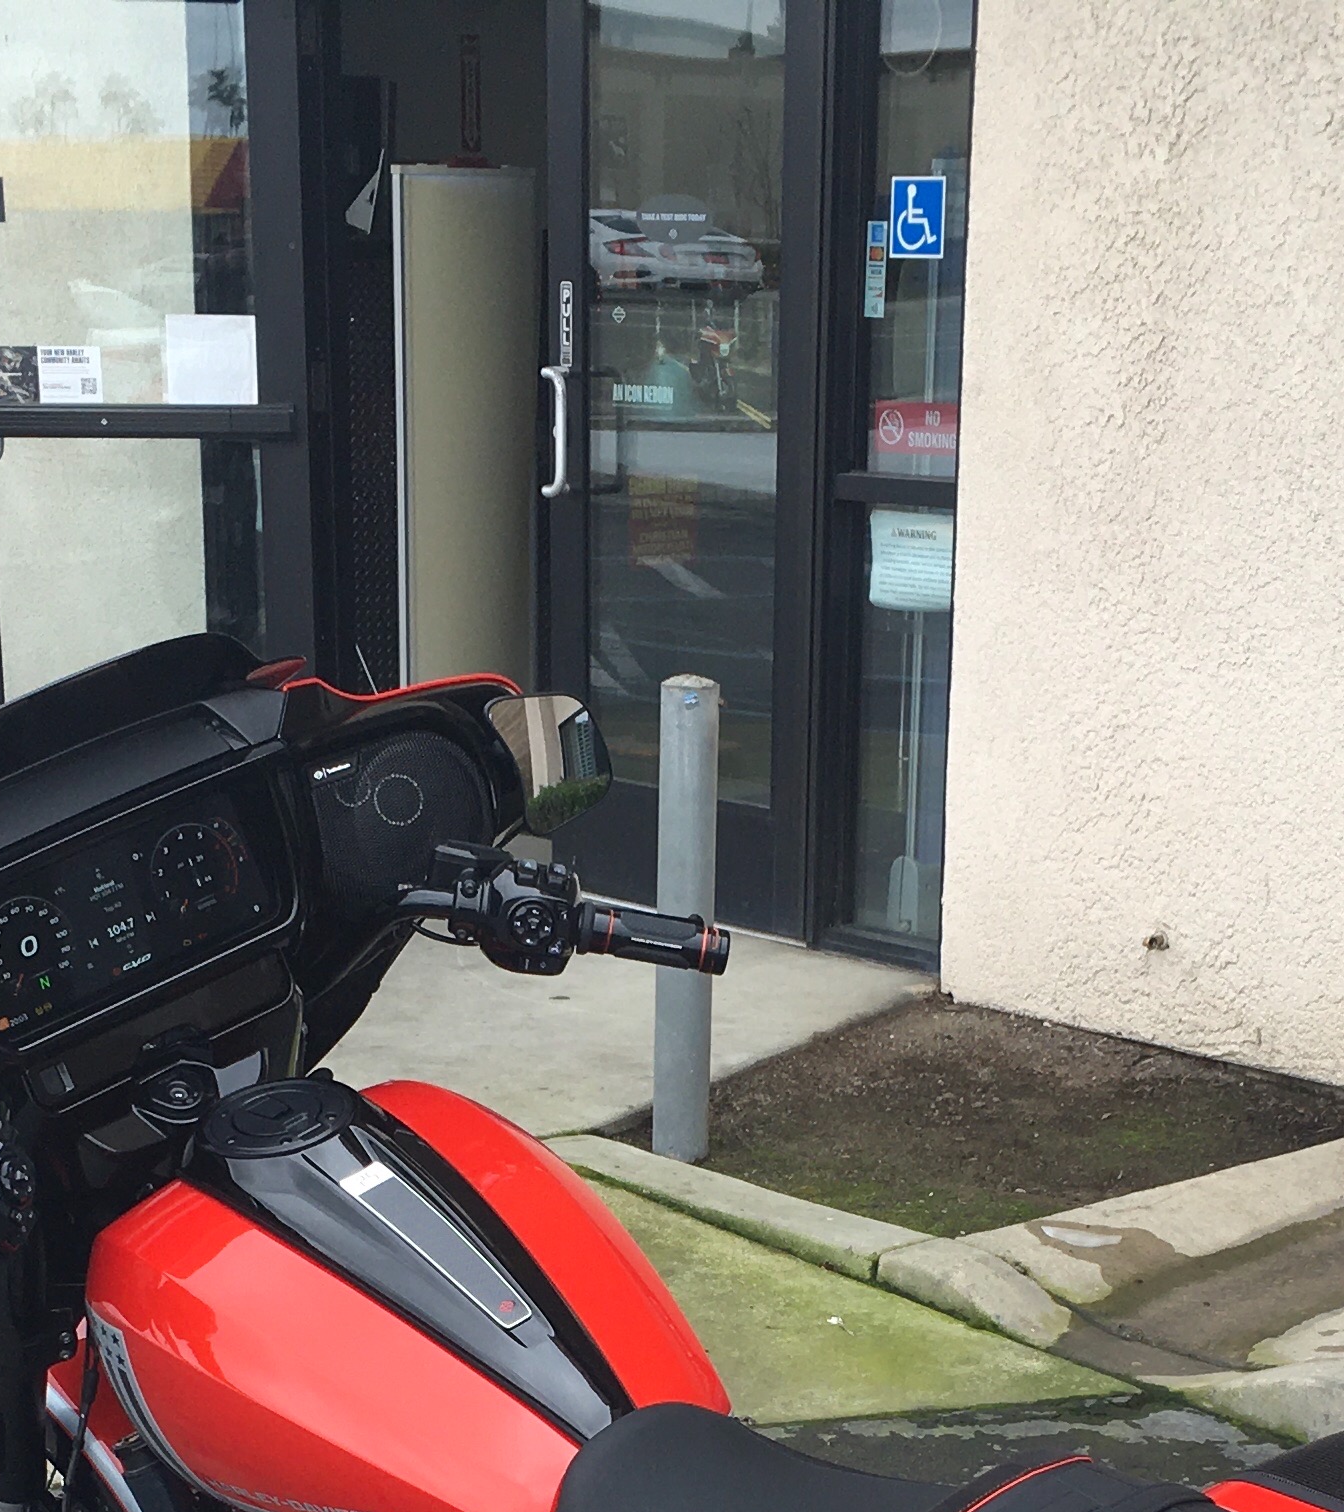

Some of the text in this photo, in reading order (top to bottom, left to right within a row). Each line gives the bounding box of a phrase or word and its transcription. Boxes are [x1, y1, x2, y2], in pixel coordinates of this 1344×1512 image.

[562, 289, 570, 345] PULL
[613, 384, 623, 401] AN
[624, 384, 642, 403] ICON
[925, 410, 940, 427] NO
[908, 432, 956, 449] SMOKING
[897, 527, 937, 540] WARNING
[107, 917, 134, 938] 104.7
[20, 935, 38, 958] 0
[122, 953, 152, 971] CVO
[39, 975, 51, 990] N
